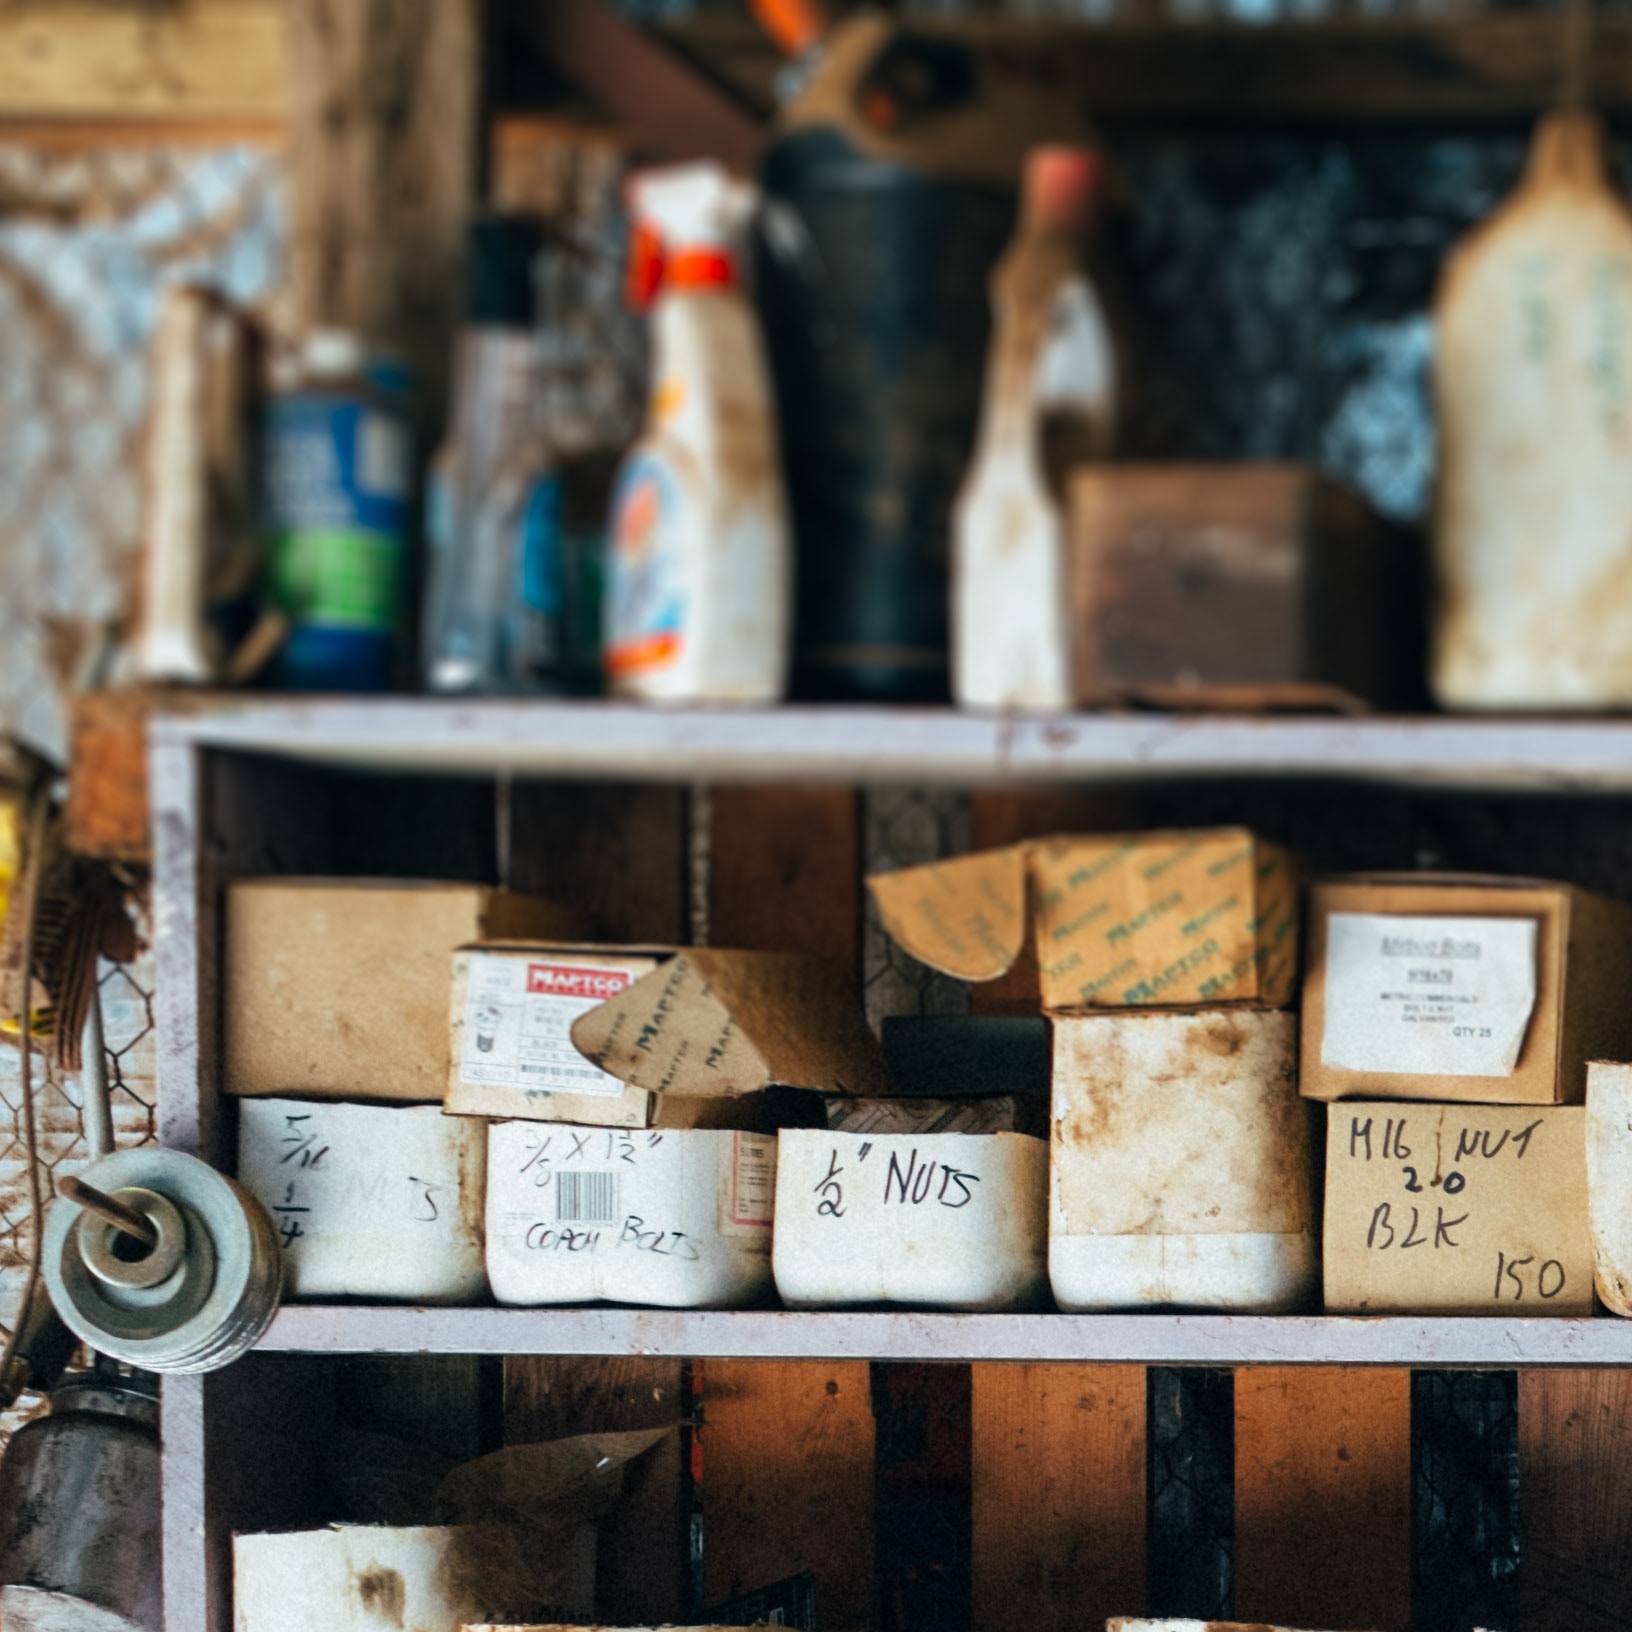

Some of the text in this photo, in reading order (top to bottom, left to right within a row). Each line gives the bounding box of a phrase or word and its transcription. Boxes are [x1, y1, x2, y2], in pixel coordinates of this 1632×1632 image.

[531, 969, 624, 993] MAPTCO
[1453, 1027, 1493, 1038] QTY 25
[1456, 1118, 1546, 1161] NUT
[884, 1148, 980, 1209] NUTS
[526, 1215, 700, 1261] COACH BOLTS
[1367, 1203, 1471, 1250] BLK
[1496, 1257, 1565, 1300] 150
